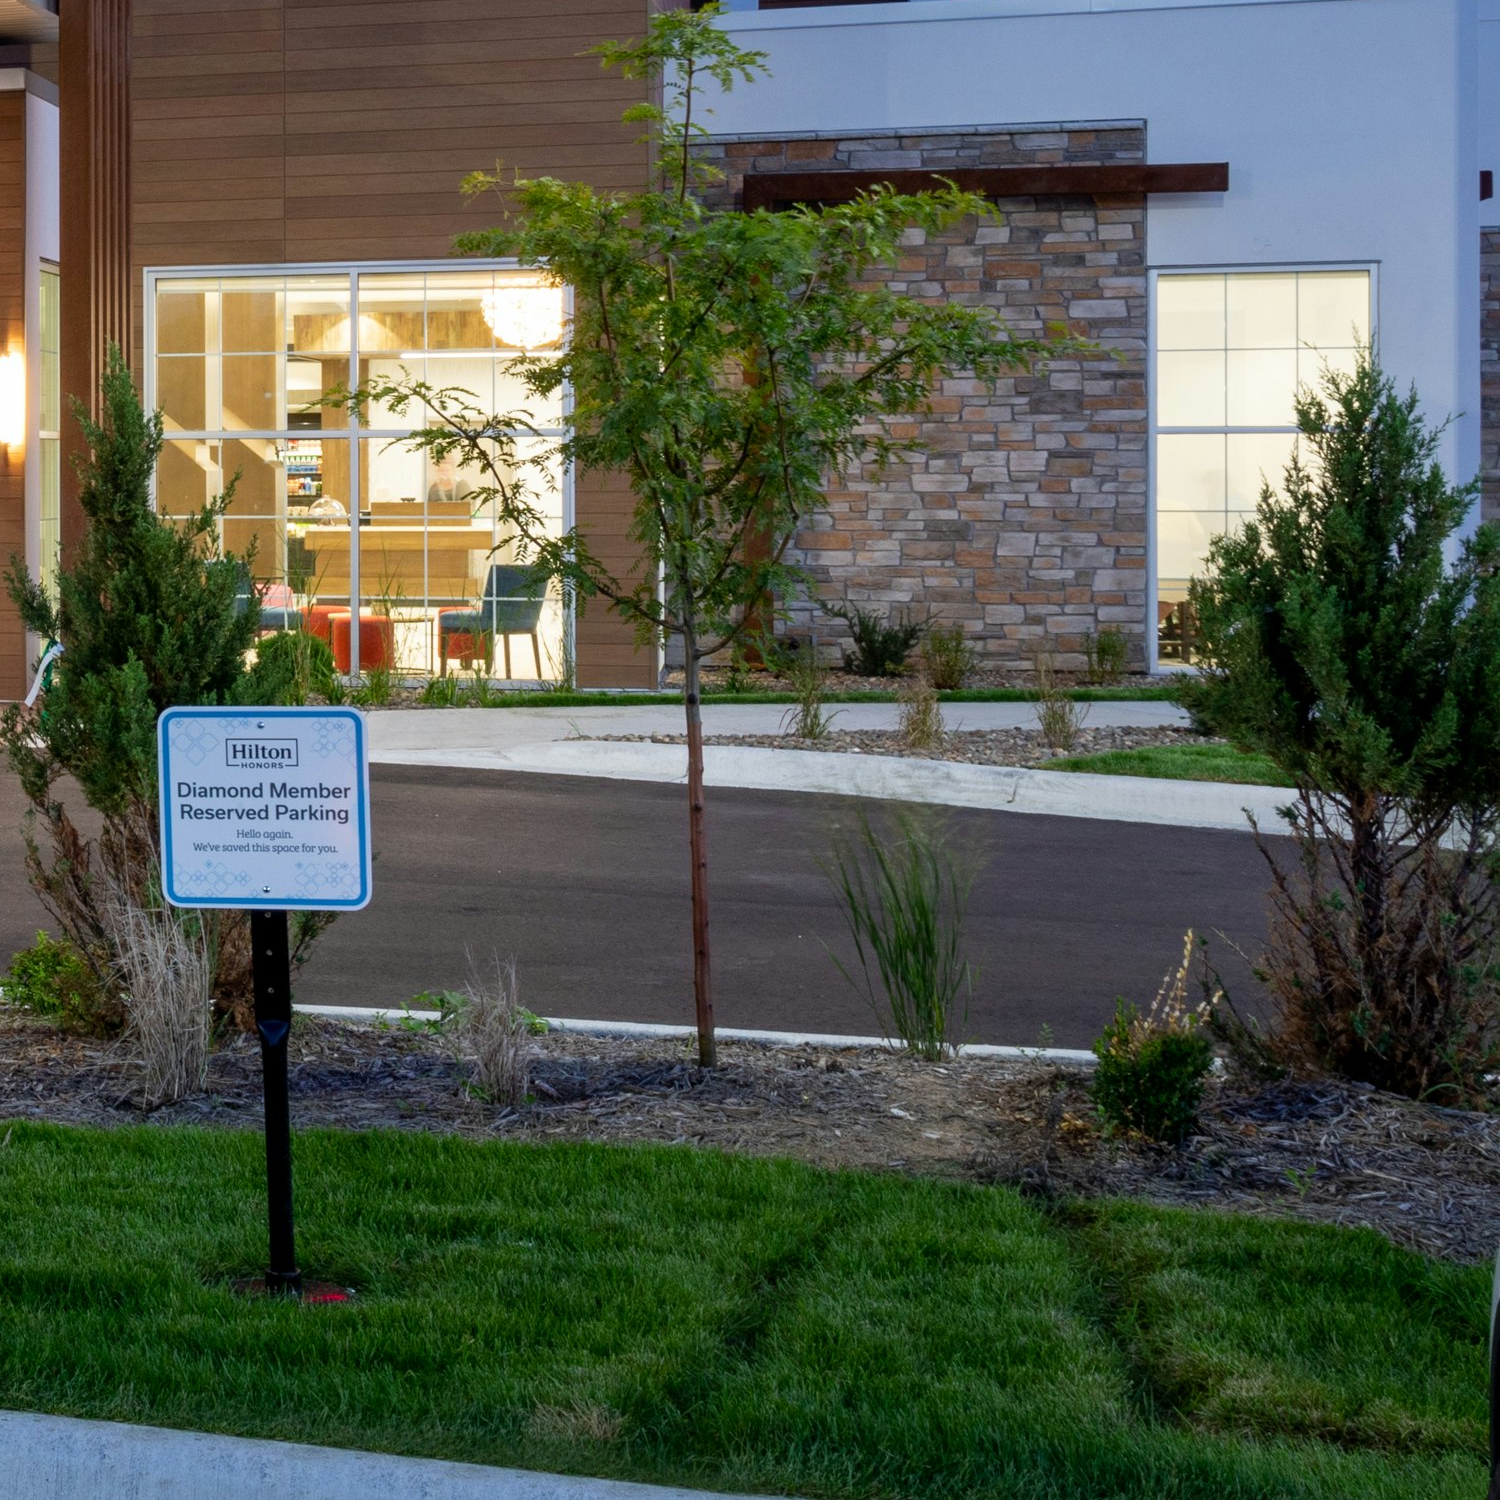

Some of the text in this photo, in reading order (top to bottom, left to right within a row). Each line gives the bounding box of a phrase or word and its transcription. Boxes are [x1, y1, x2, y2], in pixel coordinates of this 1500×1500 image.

[232, 744, 292, 760] Hilton
[177, 782, 351, 799] Diamond Member
[180, 804, 349, 824] Reserved Parking
[236, 829, 293, 841] Hello again.
[193, 842, 338, 855] We've saved this space for you.
